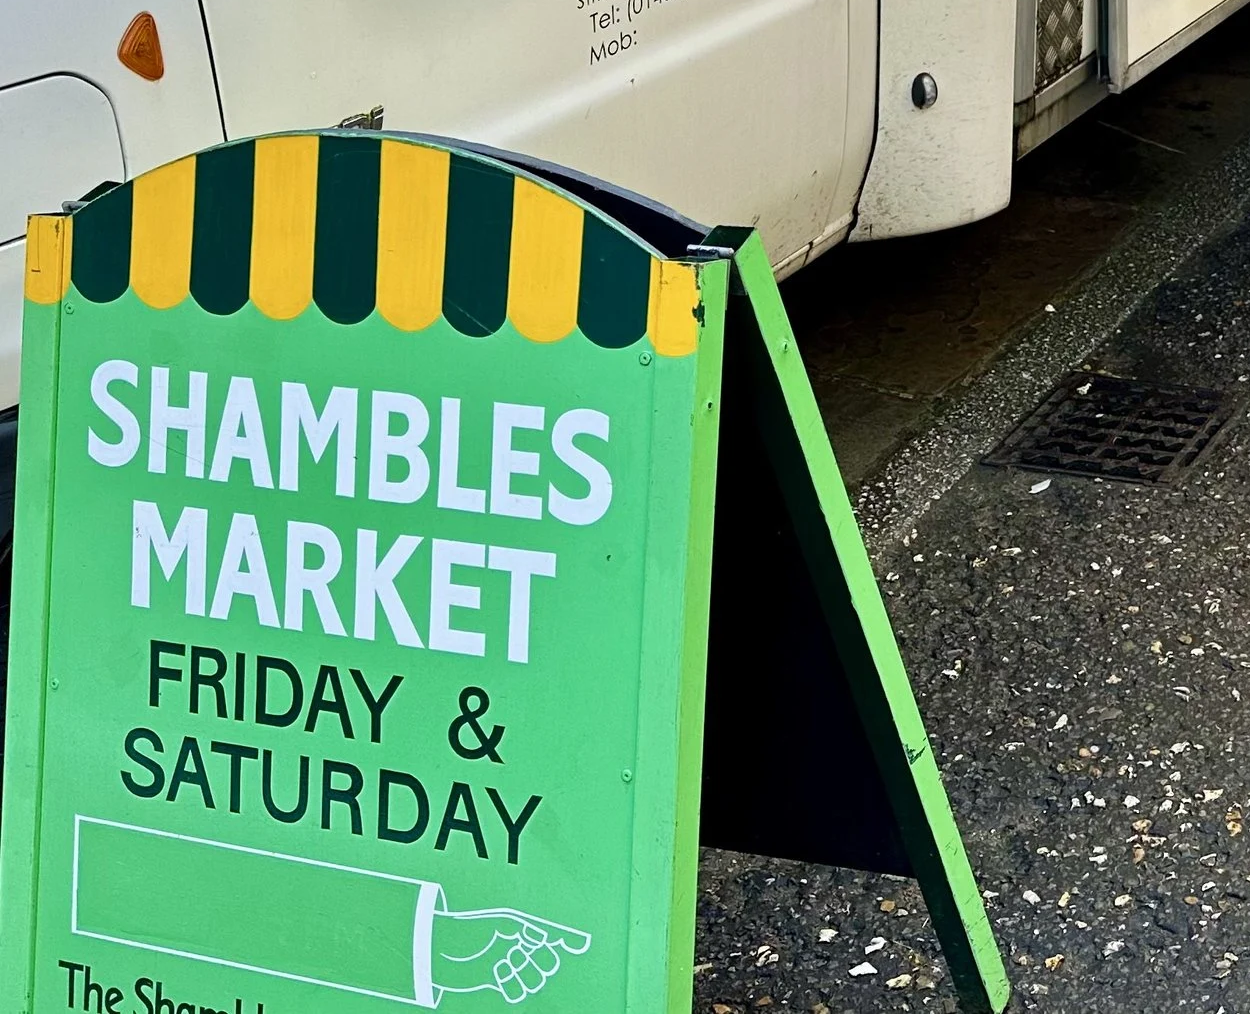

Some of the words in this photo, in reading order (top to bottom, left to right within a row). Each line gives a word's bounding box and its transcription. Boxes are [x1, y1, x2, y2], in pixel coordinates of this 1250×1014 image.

[590, 5, 620, 33] Tel:
[590, 30, 638, 65] Mob:
[88, 359, 614, 527] SHAMBLES
[131, 500, 557, 664] MARKET
[147, 639, 405, 745] FRIDAY
[448, 685, 506, 765] &
[120, 727, 542, 866] SATURDAY
[58, 960, 124, 1014] The
